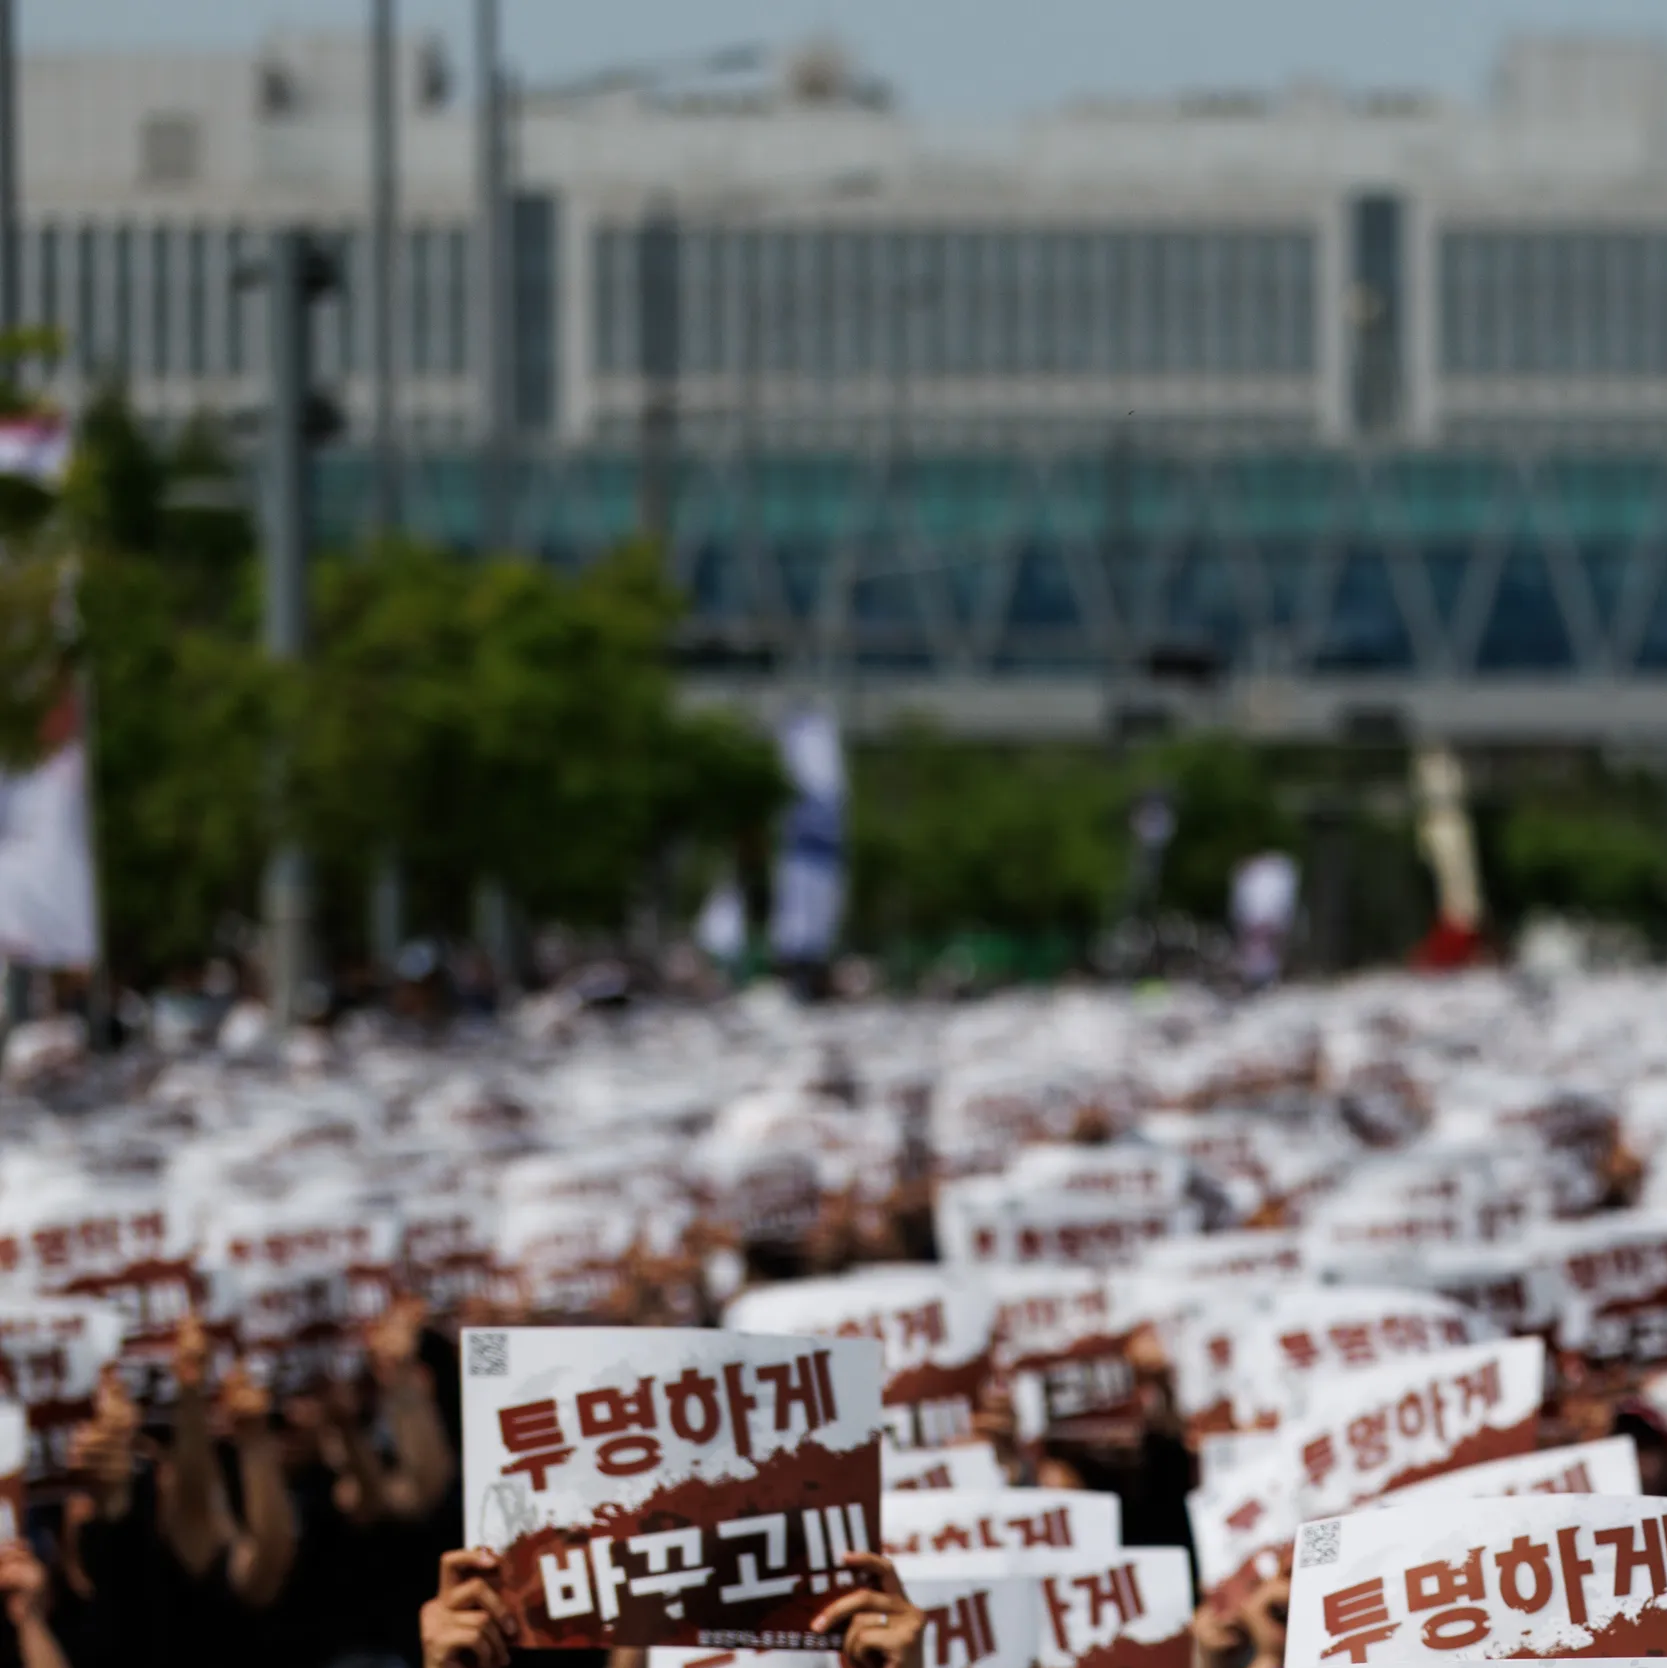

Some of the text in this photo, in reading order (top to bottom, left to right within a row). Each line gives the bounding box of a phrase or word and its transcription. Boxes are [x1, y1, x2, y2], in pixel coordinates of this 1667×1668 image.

[498, 1349, 839, 1491] 투명하게
[1300, 1359, 1503, 1486] 투명하게
[540, 1502, 868, 1621] 바꾸고!!!
